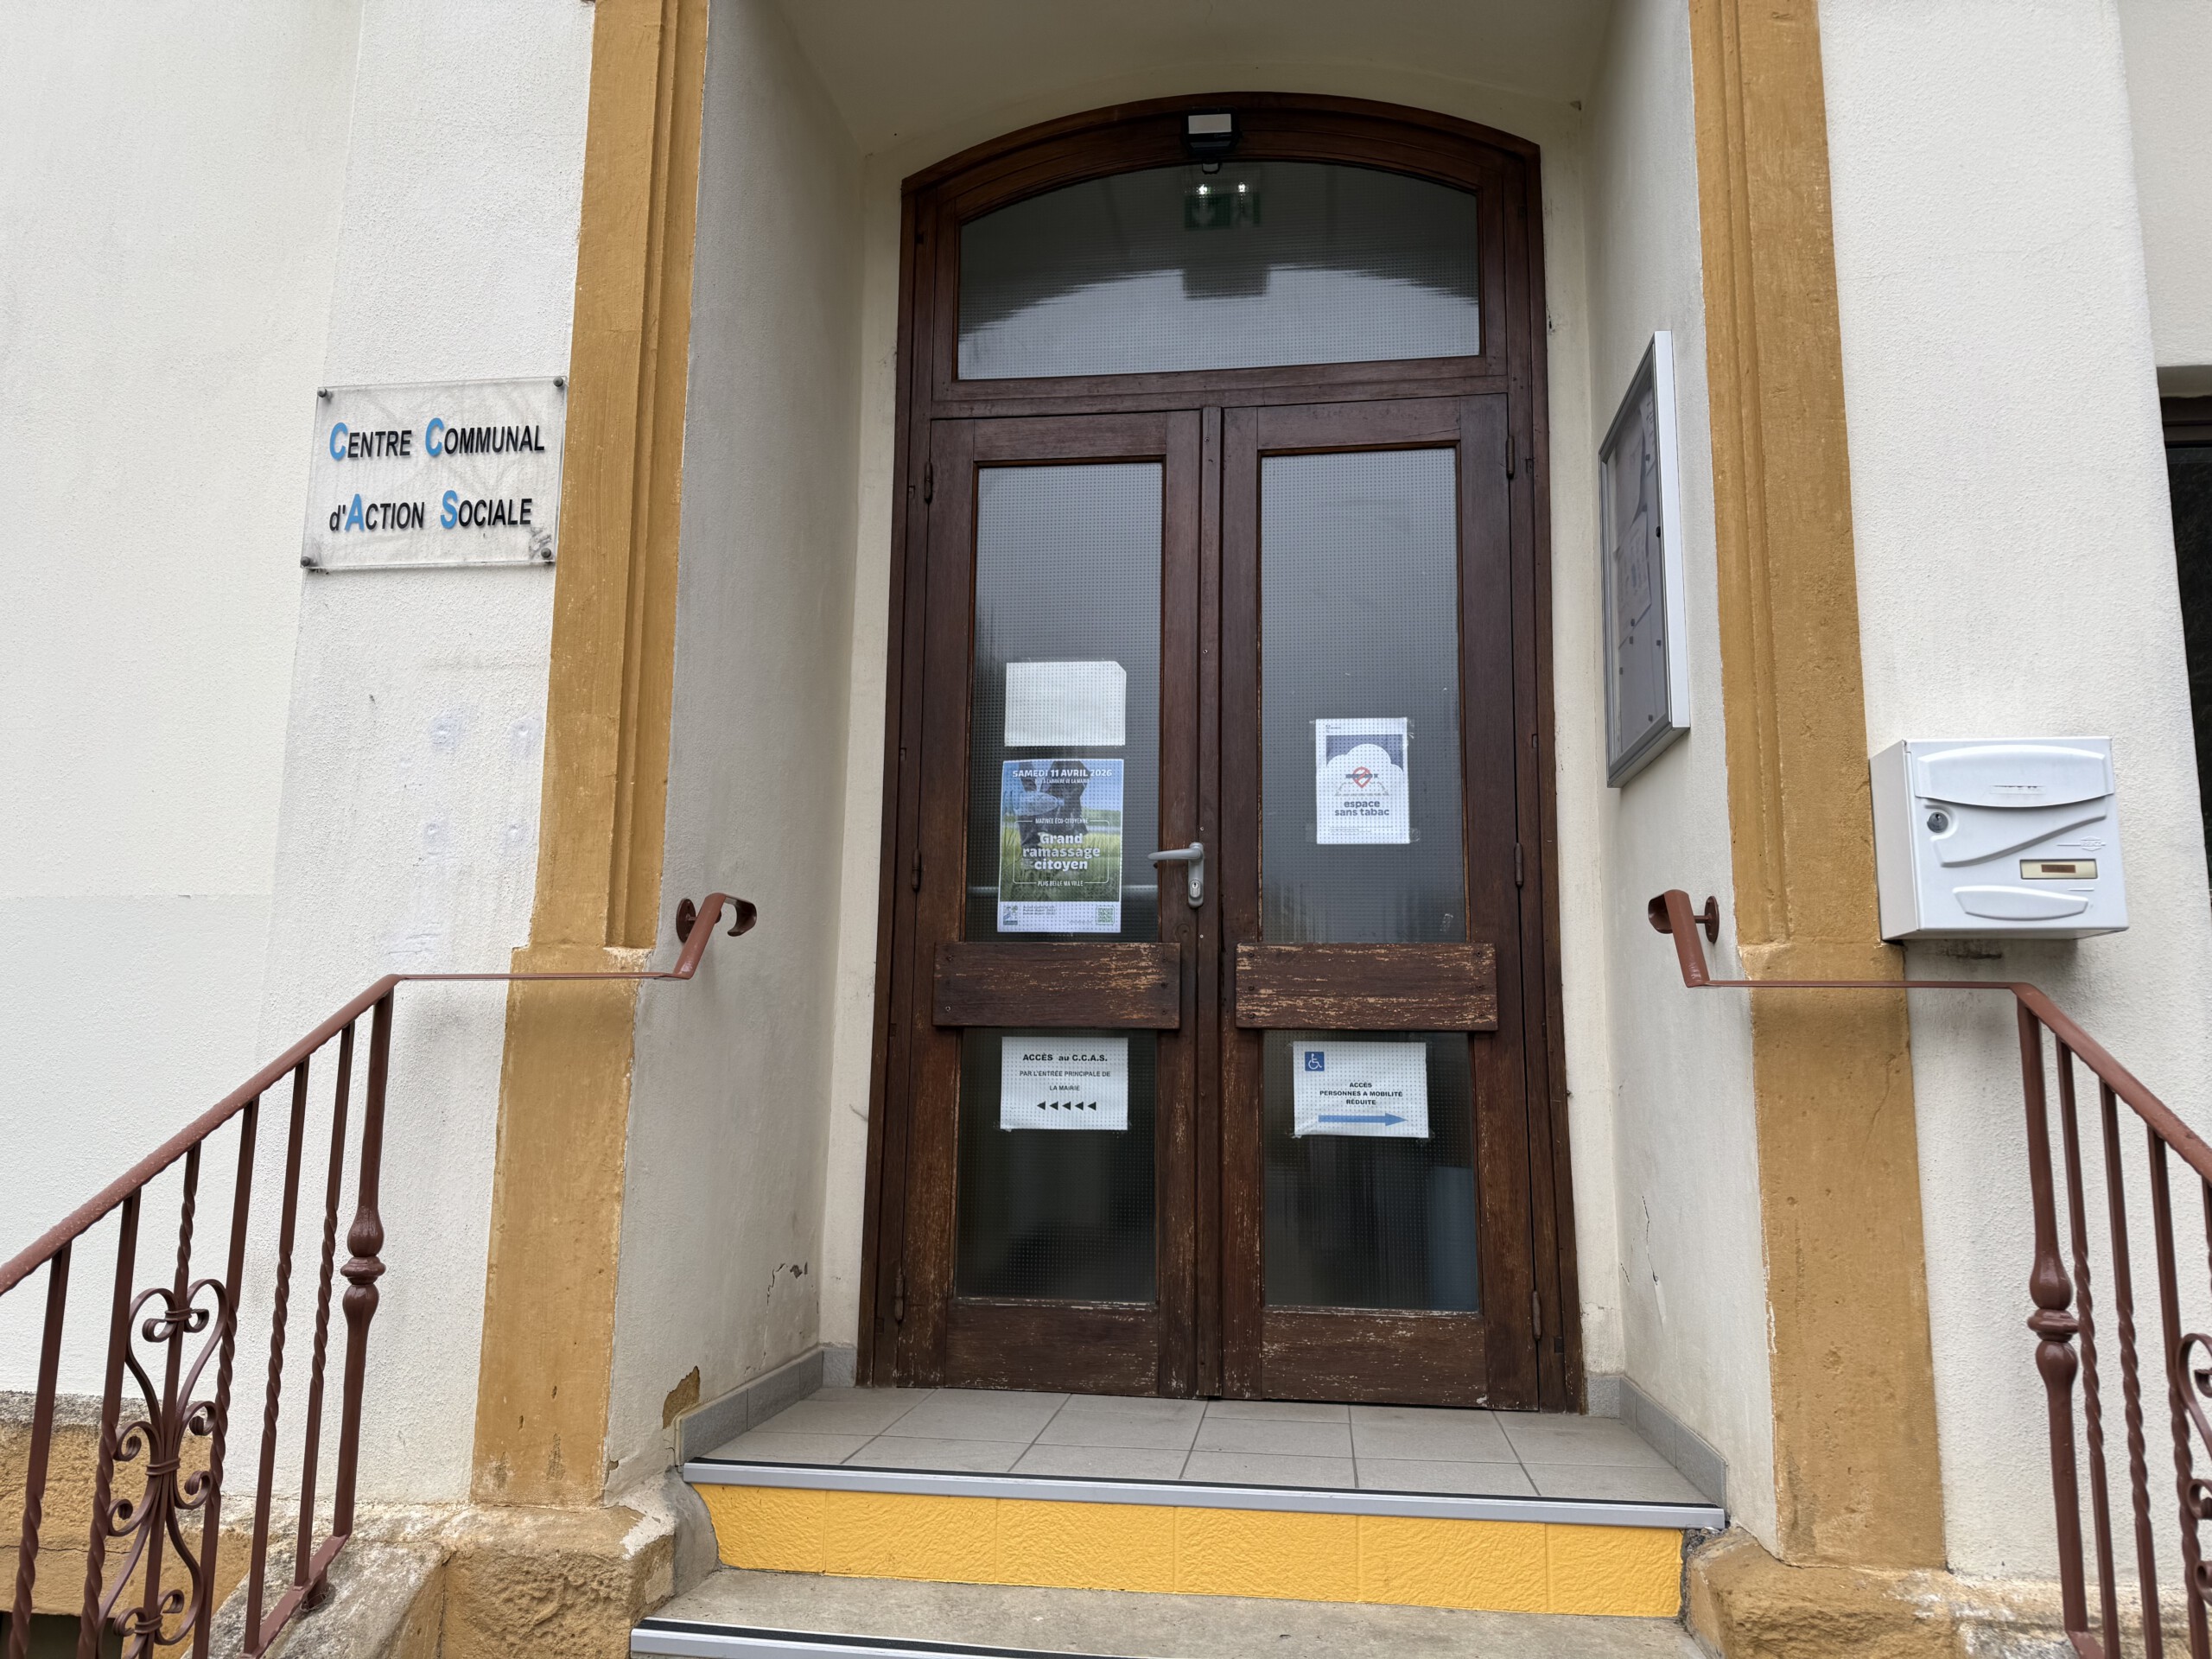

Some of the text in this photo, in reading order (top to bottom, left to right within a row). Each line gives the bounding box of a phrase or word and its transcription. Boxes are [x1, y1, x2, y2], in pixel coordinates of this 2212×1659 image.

[329, 417, 545, 461] CENTRE COMMUNAL
[329, 490, 533, 531] d'ACTION SOCIALE
[1051, 769, 1059, 778] 11
[1061, 769, 1088, 778] AVRIL
[1344, 800, 1380, 809] espace
[1359, 808, 1390, 817] tabac
[1039, 833, 1083, 844] Grand
[1022, 848, 1101, 859] ramassage
[1034, 858, 1088, 871] citoyen
[1022, 1052, 1053, 1061] ACCÈS
